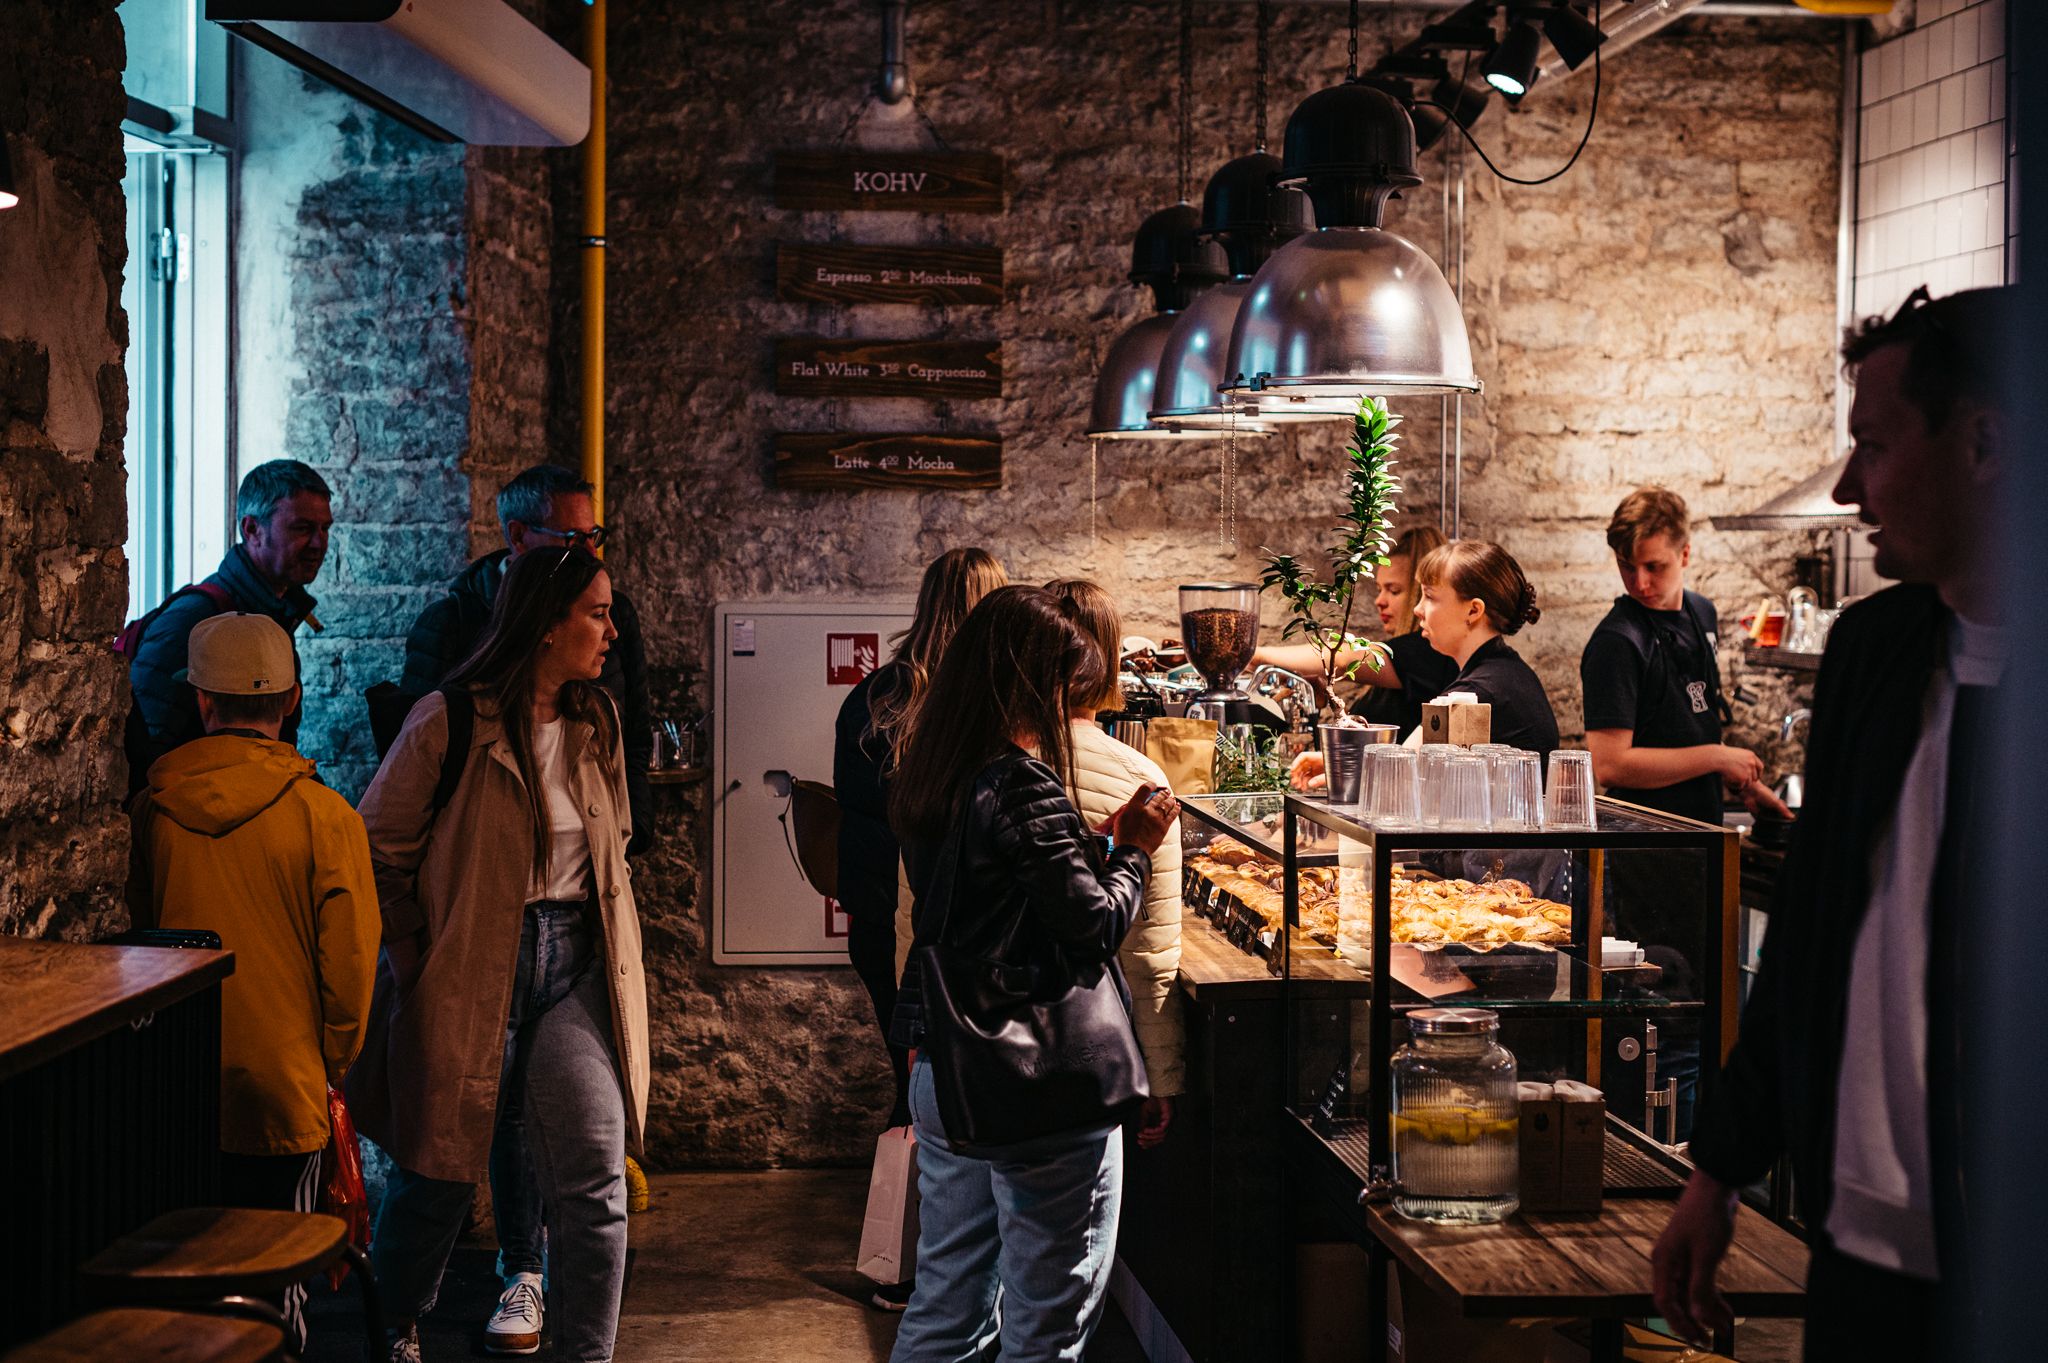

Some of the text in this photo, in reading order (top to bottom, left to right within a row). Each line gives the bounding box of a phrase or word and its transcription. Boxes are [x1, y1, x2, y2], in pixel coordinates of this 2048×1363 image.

[853, 171, 928, 192] KOHV
[816, 267, 872, 287] Espresso
[909, 269, 982, 286] Macchiato
[791, 361, 820, 377] Flat
[825, 361, 870, 377] White
[907, 363, 987, 382] Cappuccino
[834, 454, 870, 469] Latte
[907, 455, 955, 470] Mocha
